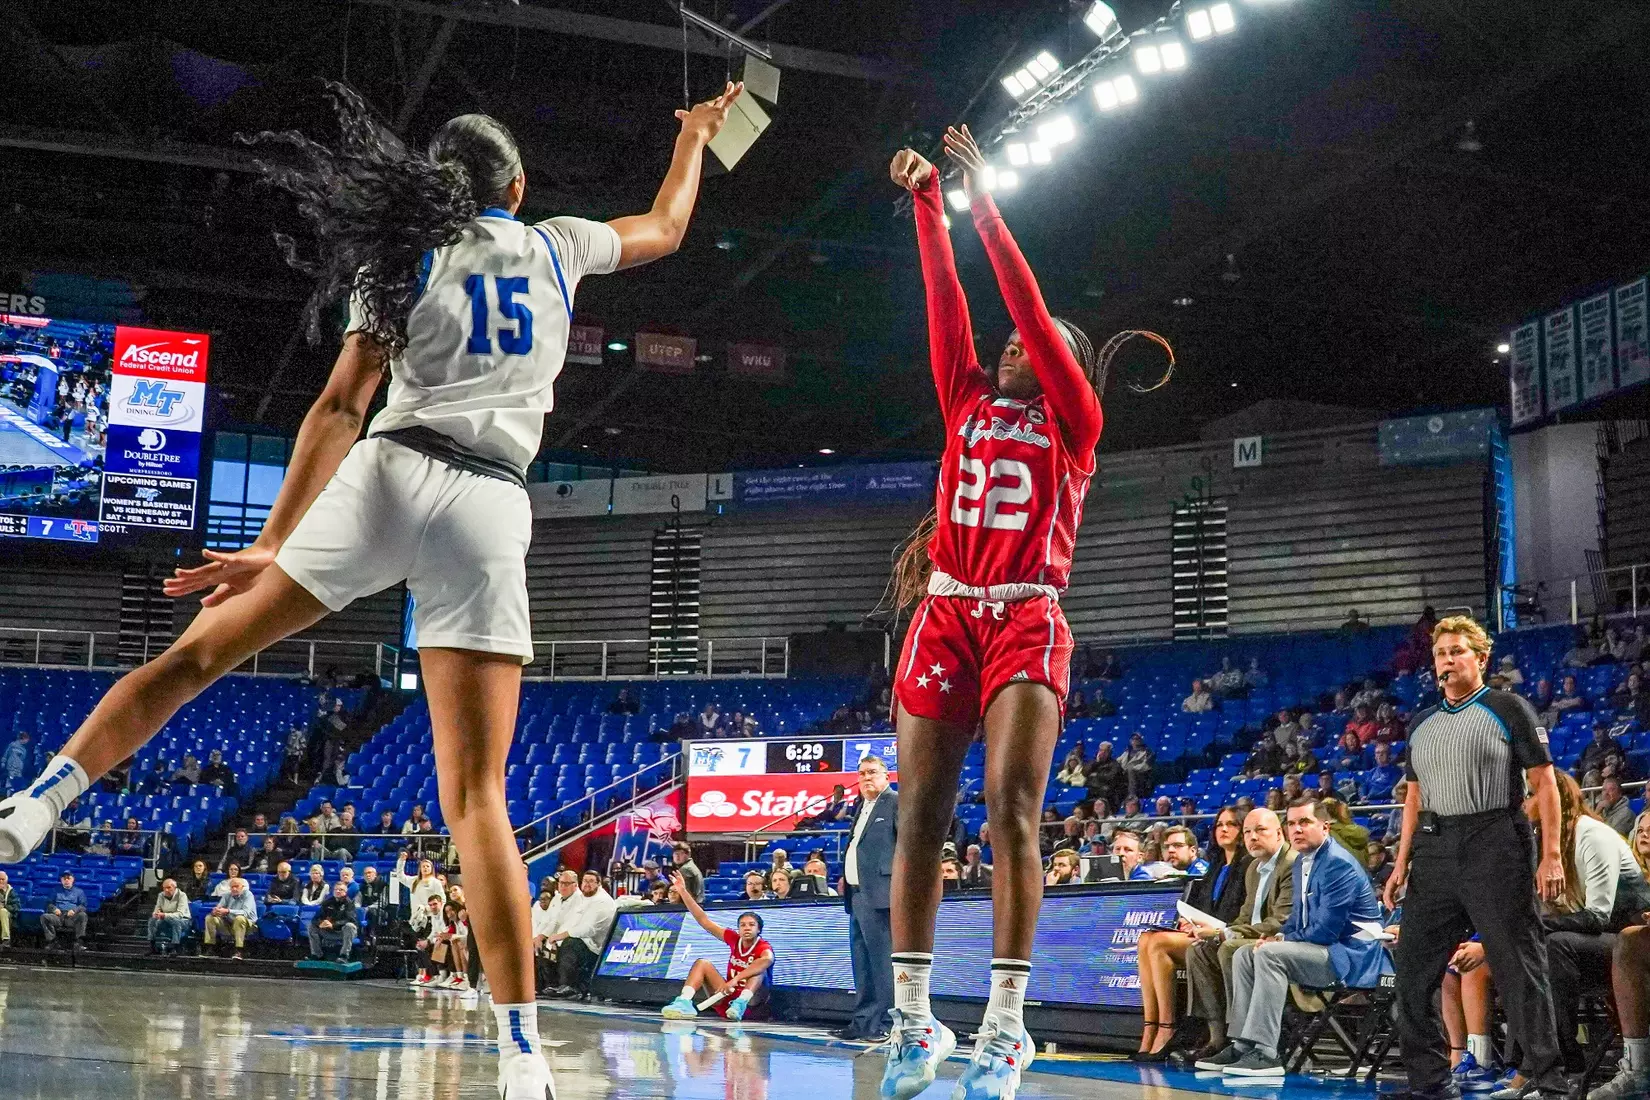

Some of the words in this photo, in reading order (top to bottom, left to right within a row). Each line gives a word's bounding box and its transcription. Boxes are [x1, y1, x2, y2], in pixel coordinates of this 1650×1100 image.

[0, 294, 45, 314] ERS
[465, 274, 533, 355] 15
[121, 344, 198, 367] Ascend
[650, 345, 682, 357] UTEP
[120, 361, 146, 369] Federal
[148, 364, 170, 372] Credit
[742, 355, 771, 366] WKU
[127, 379, 185, 417] MT
[126, 408, 154, 416] DINING
[1239, 443, 1257, 460] M
[138, 460, 145, 468] by
[107, 476, 157, 486] UPCOMING
[159, 480, 192, 489] GAMES
[716, 479, 725, 495] L
[135, 487, 161, 502] MT
[951, 454, 1031, 531] 22
[103, 497, 141, 507] WOMEN'S
[143, 501, 193, 511] BASKETBALL
[125, 507, 170, 517] KENNESAW
[0, 525, 14, 533] ULS
[21, 518, 27, 526] 4
[41, 520, 54, 535] 7
[99, 524, 129, 534] SCOTT.
[738, 748, 751, 768] 7
[786, 744, 824, 760] 6:29
[855, 743, 871, 765] 7
[795, 763, 811, 772] 1st
[740, 789, 827, 817] State
[1123, 911, 1166, 926] MIDDLE
